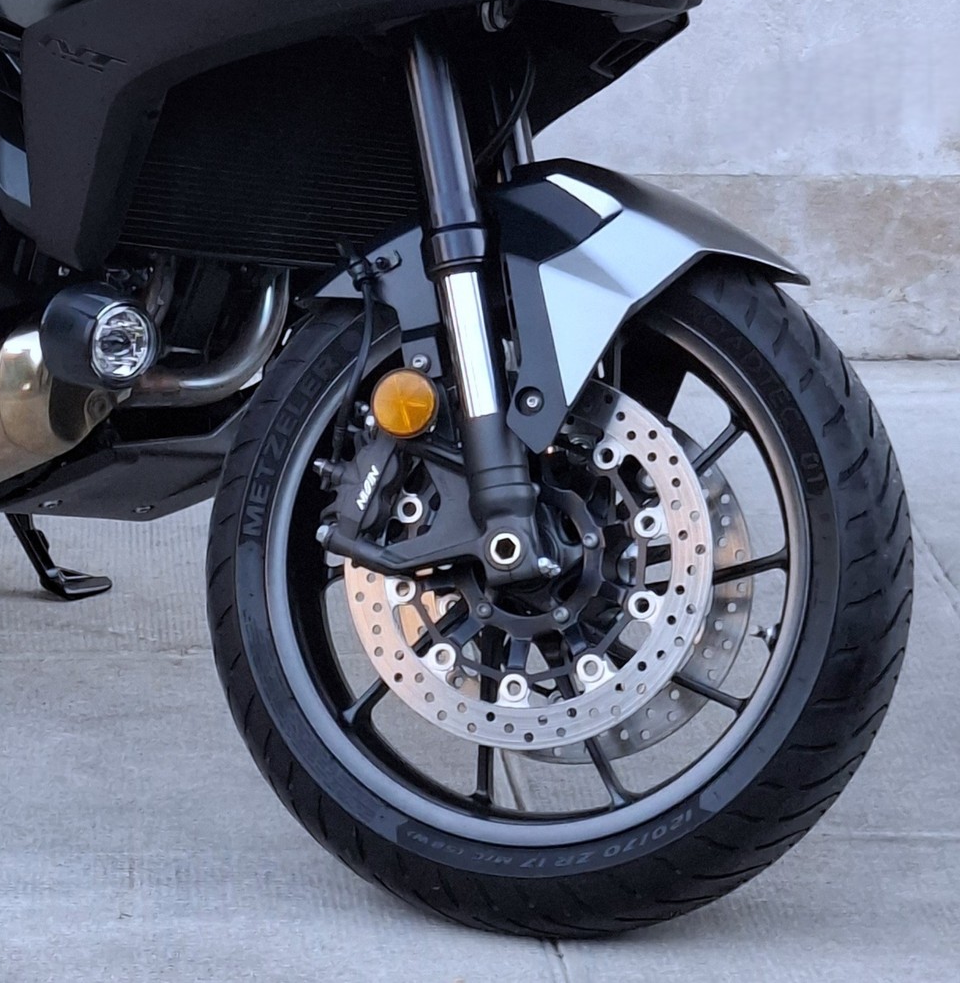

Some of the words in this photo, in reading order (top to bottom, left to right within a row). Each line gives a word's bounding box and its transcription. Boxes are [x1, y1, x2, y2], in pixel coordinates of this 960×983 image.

[243, 356, 336, 536] METZELER
[605, 808, 693, 858] 120/70
[520, 854, 546, 869] 17
[554, 850, 594, 867] ZR
